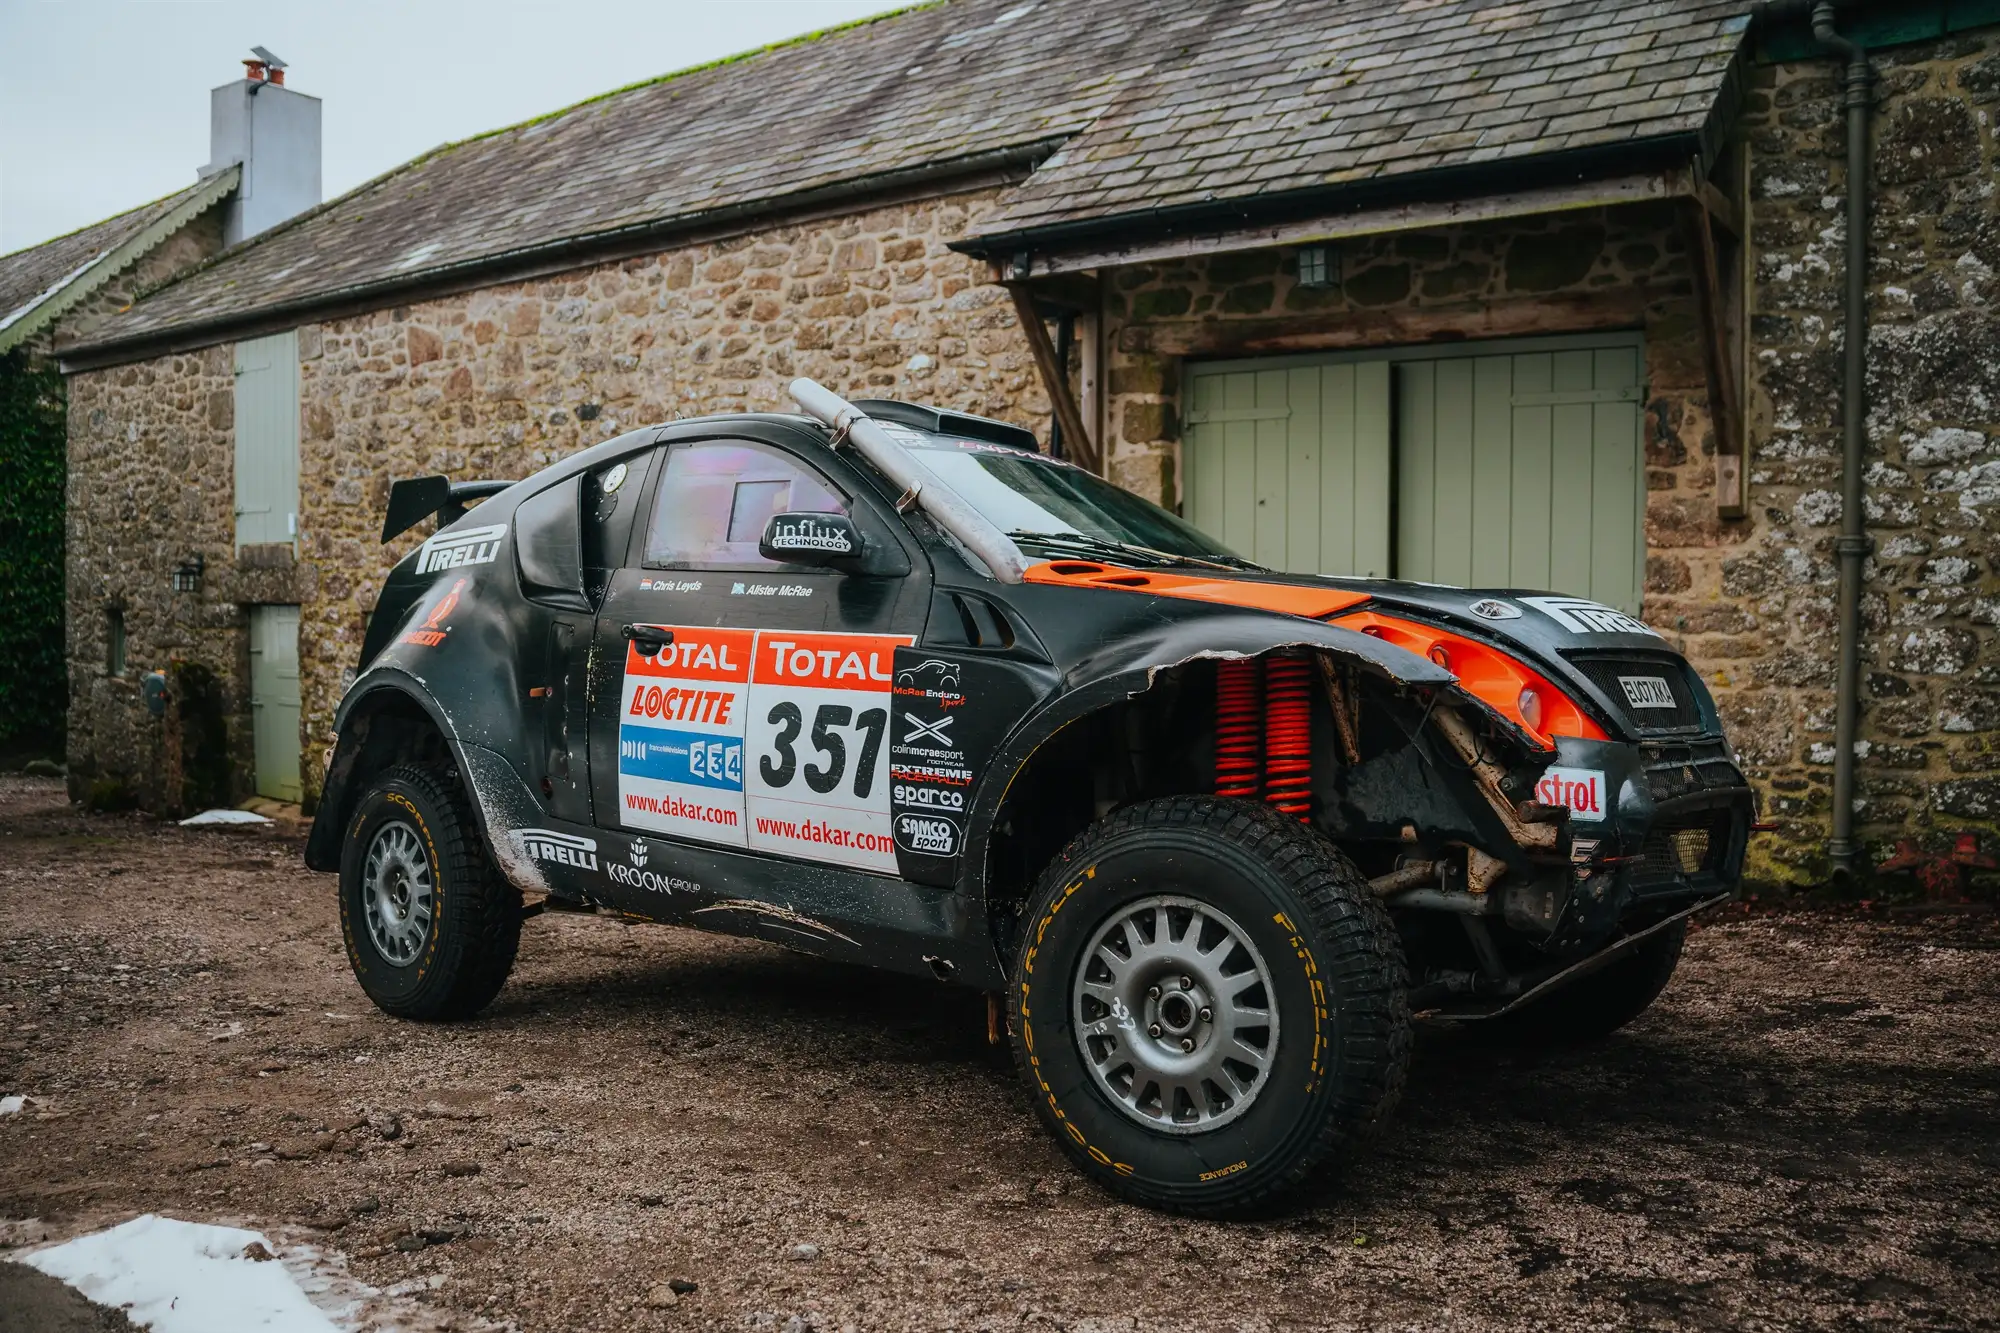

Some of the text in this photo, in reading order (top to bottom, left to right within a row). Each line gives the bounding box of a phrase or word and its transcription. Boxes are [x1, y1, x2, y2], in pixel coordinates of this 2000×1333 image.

[775, 519, 847, 541] influx
[415, 523, 508, 575] PIRELLI
[774, 536, 850, 551] TECHNOLOGY
[652, 580, 702, 594] Chris Leyds
[746, 584, 813, 597] Alister McRae
[643, 642, 741, 672] OTAL
[768, 641, 893, 682] TOTAL
[1623, 680, 1652, 703] EU07
[629, 685, 735, 726] LOCTITE
[759, 701, 888, 799] 351
[891, 763, 973, 780] EXTREME
[926, 759, 965, 768] FOOTWEAR
[894, 785, 963, 808] sparco
[626, 793, 738, 827] www.dakar.com
[756, 817, 895, 854] www.dakar.com
[902, 818, 951, 838] SAMCO
[508, 828, 599, 872] PIRELLI
[916, 836, 948, 850] sport
[607, 862, 701, 896] KROON GROUP
[1272, 911, 1328, 1076] PIRELLI
[1199, 1160, 1248, 1182] ENDURANCE
